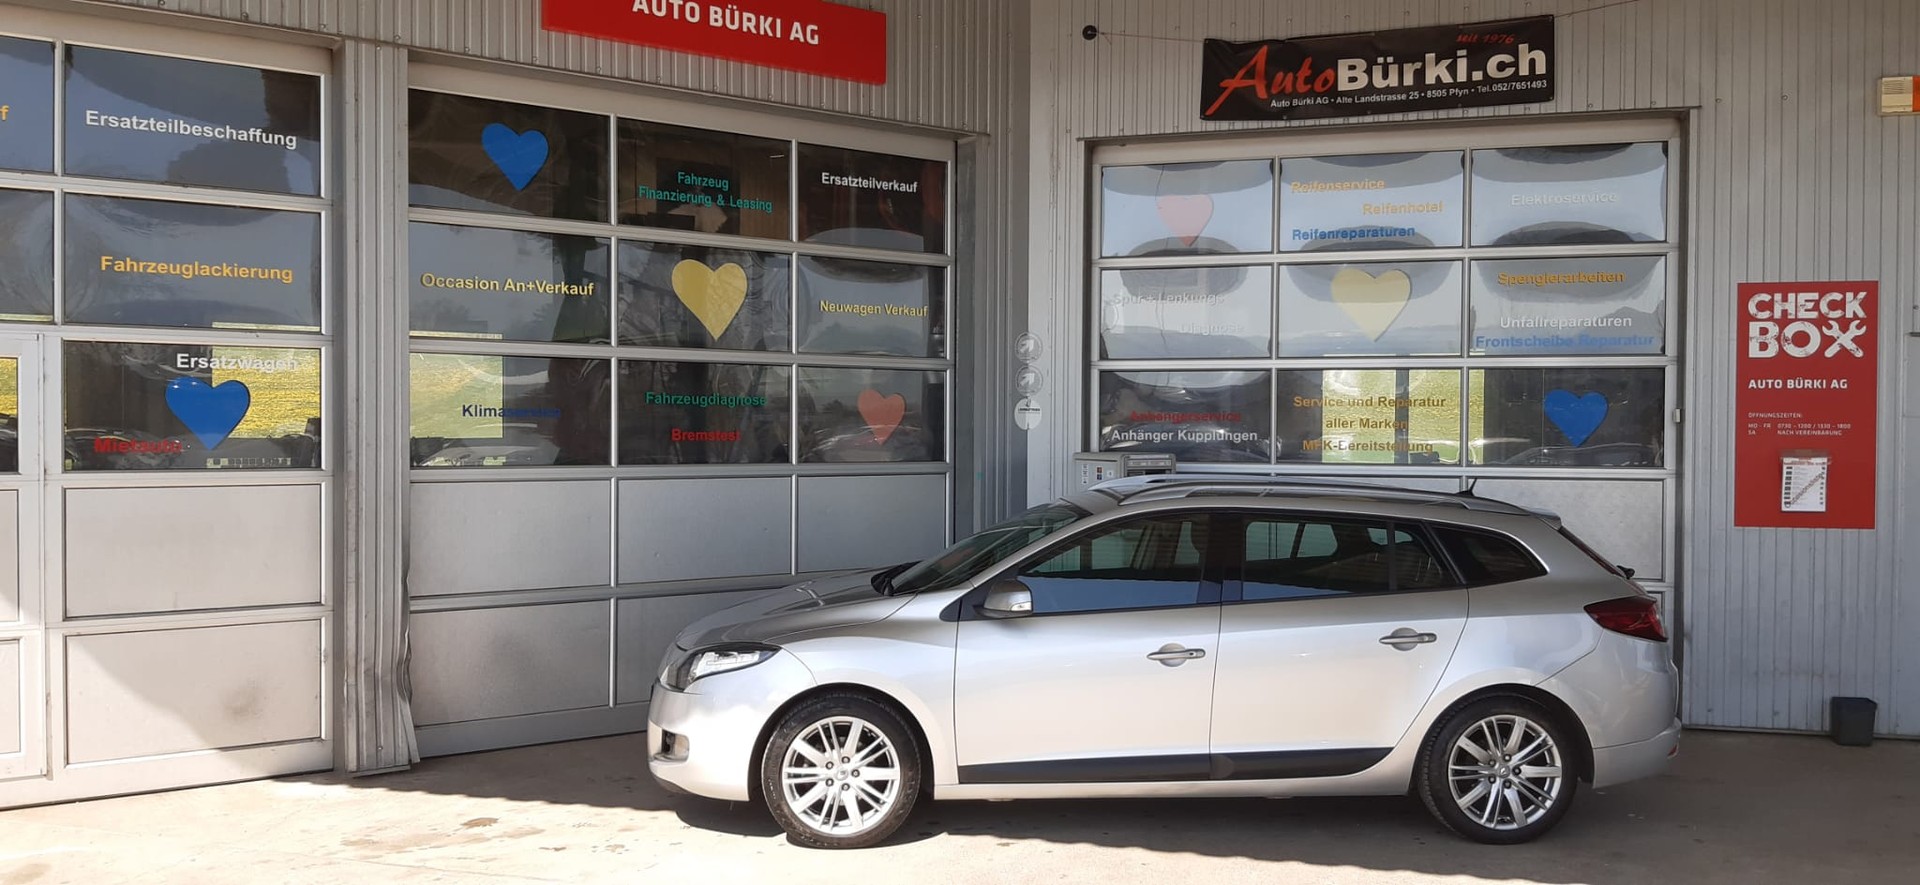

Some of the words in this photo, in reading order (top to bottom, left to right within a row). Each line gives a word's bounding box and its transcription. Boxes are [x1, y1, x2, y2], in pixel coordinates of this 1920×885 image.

[632, 0, 700, 23] AUTO
[709, 4, 781, 38] BÜRKI
[789, 22, 820, 45] AG
[1271, 99, 1290, 108] Auto
[1315, 96, 1329, 105] AG
[1336, 95, 1352, 104] Alte
[1354, 93, 1406, 103] Landstrasse
[1409, 91, 1419, 100] 25
[1427, 89, 1447, 98] 8505
[1449, 88, 1469, 97] Pfyn
[85, 110, 297, 150] Ersatzteilbeschaffung
[677, 172, 729, 191] Fahrzeug
[821, 172, 918, 193] Ersatzteilverkauf
[1290, 179, 1385, 193] Reifenservice
[639, 185, 712, 207] Finanzierung
[716, 194, 725, 206] &
[730, 196, 772, 213] Leasing
[1511, 192, 1618, 206] Elektroservice
[1362, 201, 1443, 215] Reifenhotel
[1292, 226, 1416, 240] Reifenreparaturen
[101, 256, 293, 283] Fahrzeuglackierung
[420, 272, 499, 291] Occasion
[504, 278, 595, 296] An+Verkauf
[1498, 271, 1626, 287] Spenglerarbeiten
[820, 300, 881, 317] Neuwagen
[884, 303, 929, 317] Verkauf
[1748, 292, 1867, 319] CHECK
[1500, 315, 1632, 330] Unfallreparaturen
[1475, 335, 1574, 349] Frontscheibe
[1578, 333, 1655, 348] Reparatur
[177, 353, 298, 373] Ersatzwagen
[1748, 379, 1782, 389] AUTO
[1787, 377, 1826, 389] BÜRKI
[1830, 379, 1848, 388] AG
[645, 391, 767, 408] Fahrzeugdiagnose
[1293, 396, 1347, 408] Service
[1348, 396, 1373, 407] und
[1378, 396, 1447, 409] Reparatur
[1326, 418, 1355, 429] aller
[1359, 418, 1409, 429] Marken
[671, 428, 741, 442] Bremstest
[1111, 429, 1173, 443] Anhänger
[1177, 430, 1258, 443] Kupplungen
